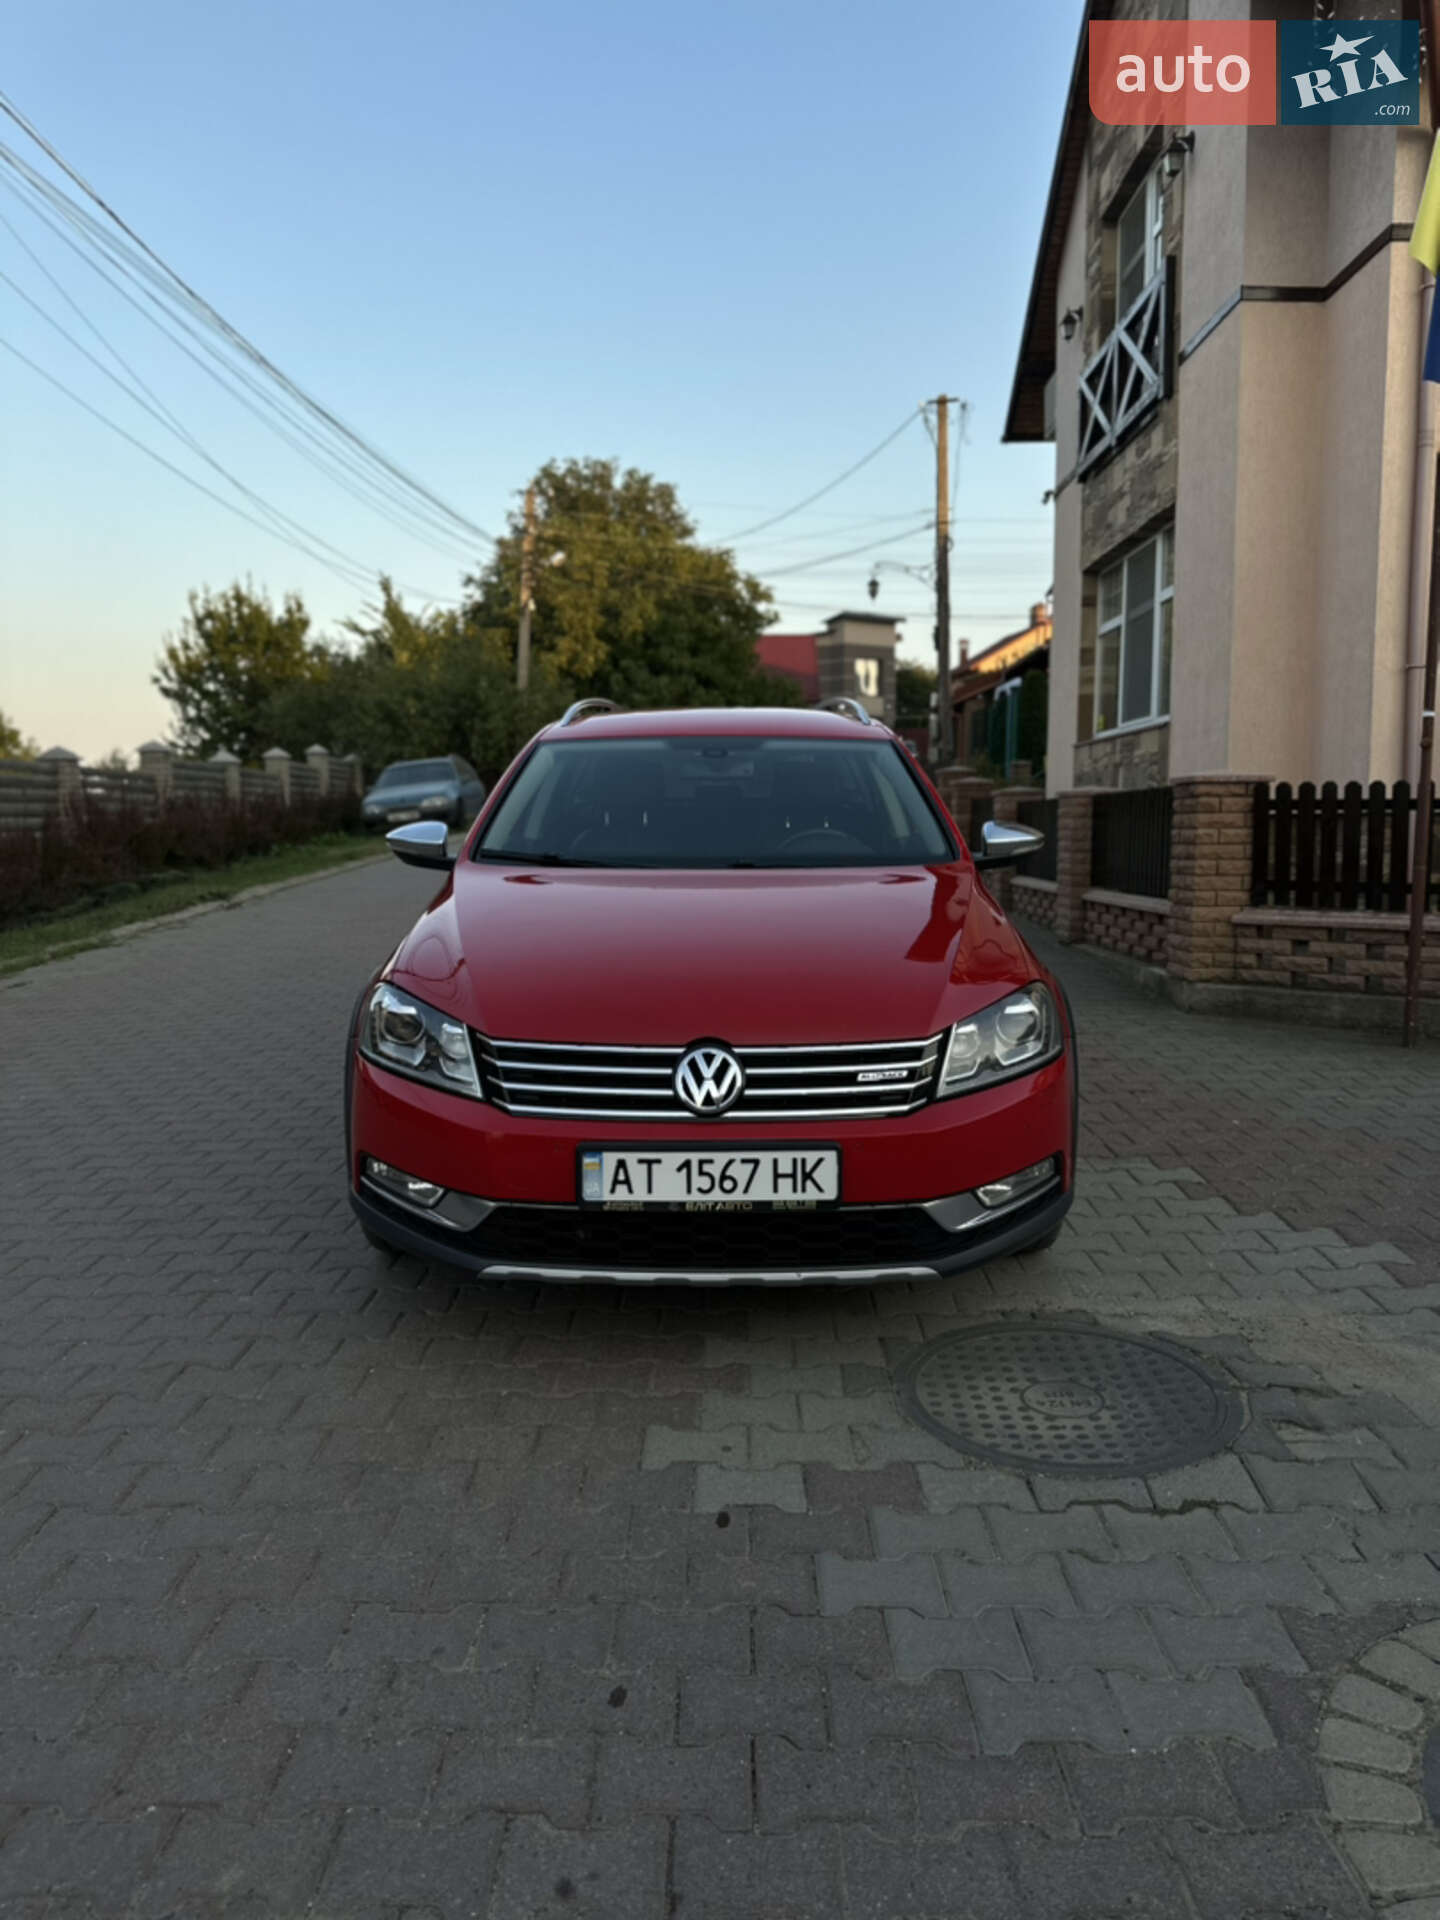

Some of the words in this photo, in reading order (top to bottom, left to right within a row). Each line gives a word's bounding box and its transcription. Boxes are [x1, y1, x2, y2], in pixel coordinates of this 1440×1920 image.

[609, 1158, 662, 1194] AT
[676, 1158, 761, 1194] 1567
[772, 1157, 825, 1194] HK
